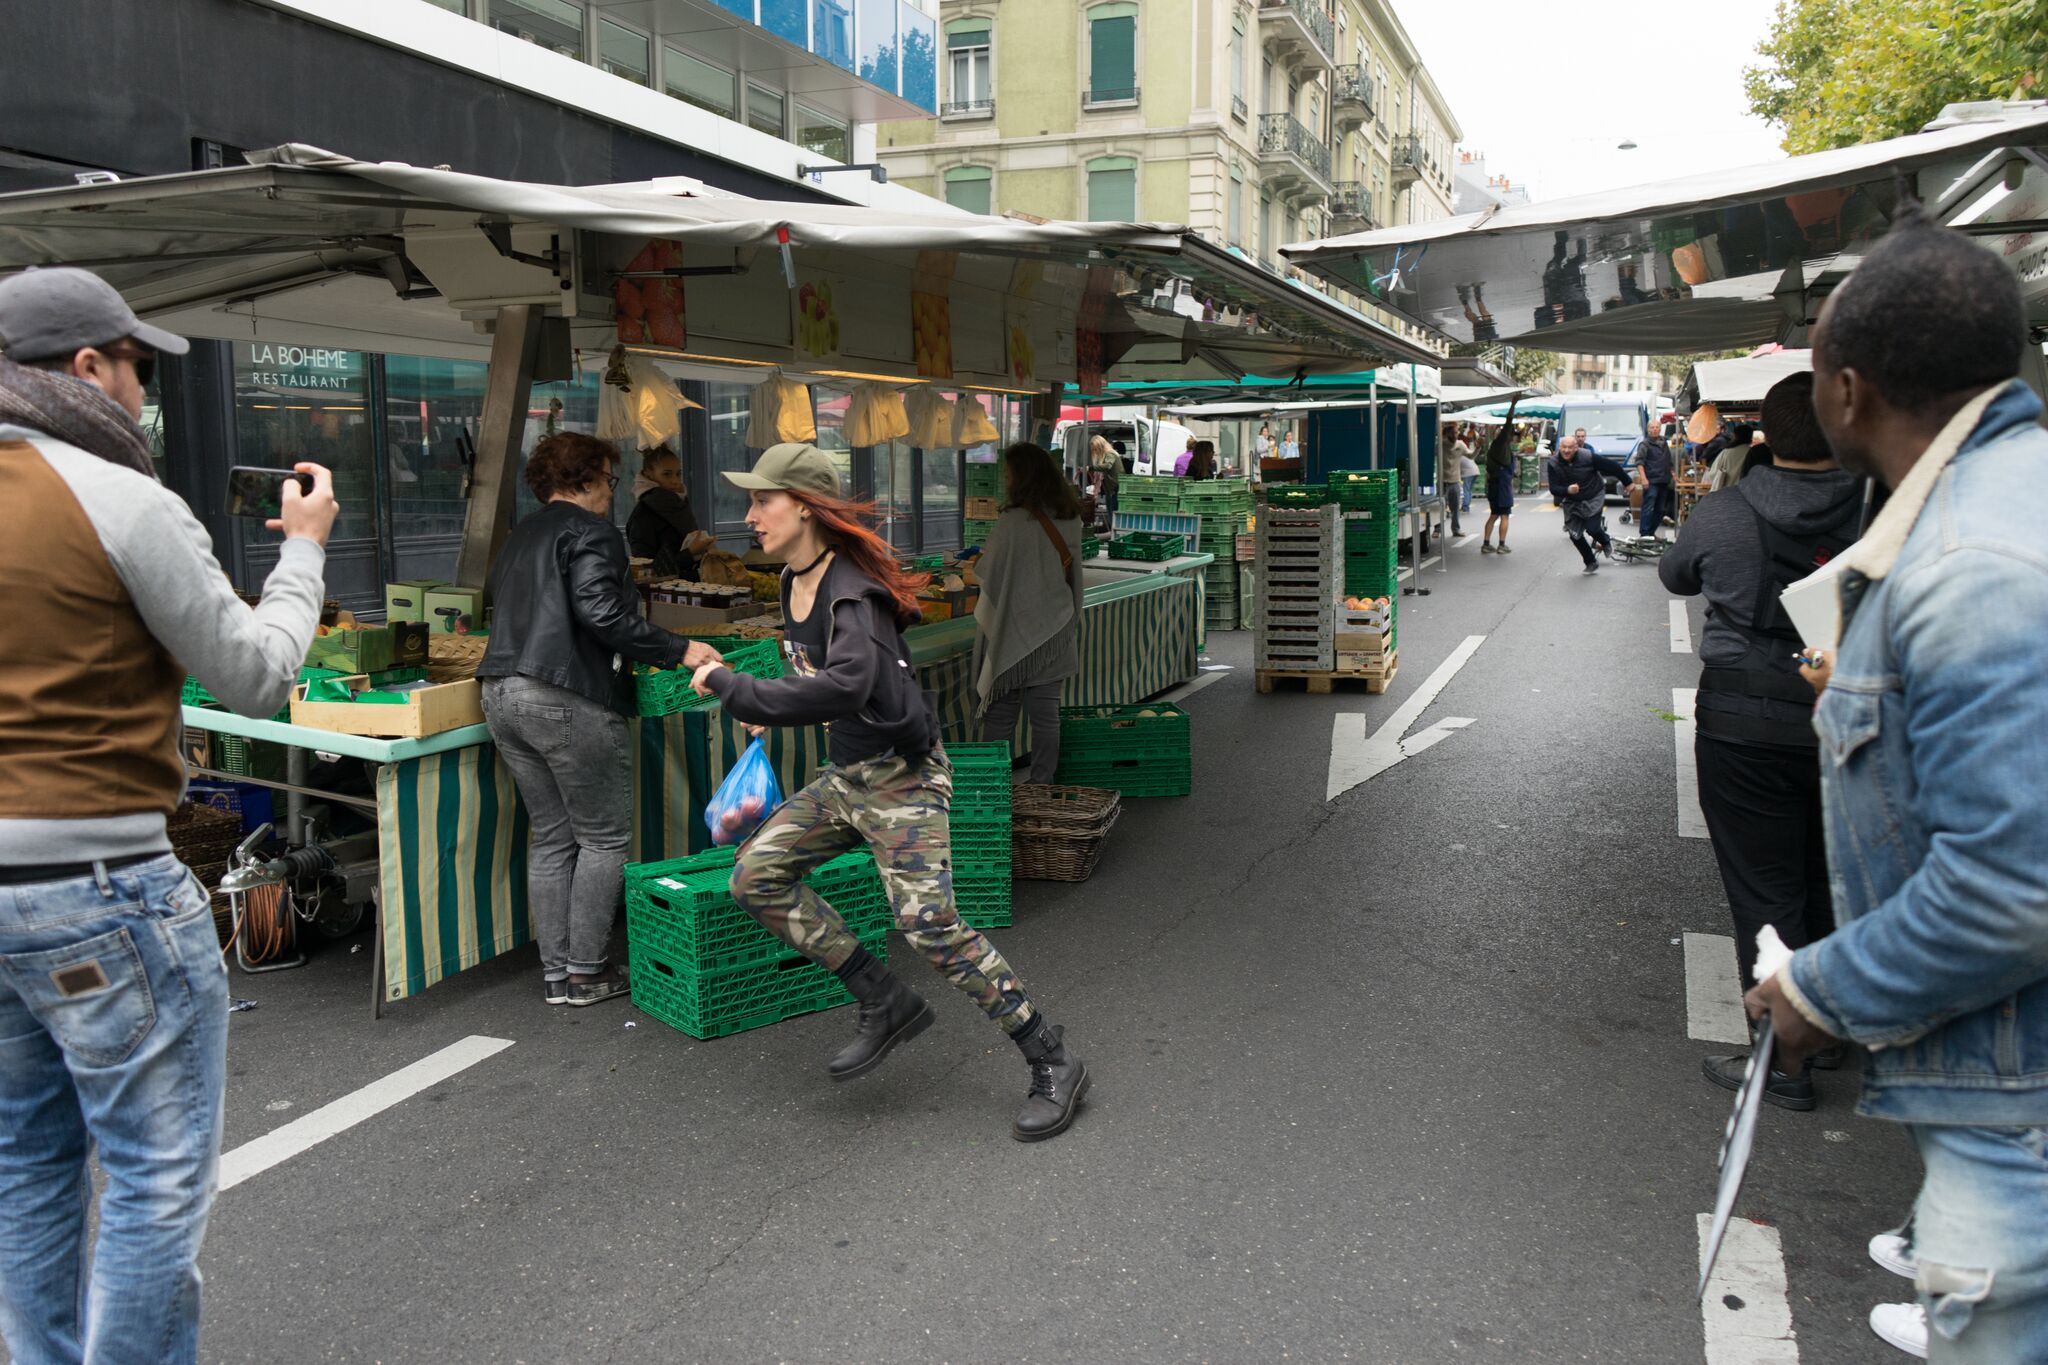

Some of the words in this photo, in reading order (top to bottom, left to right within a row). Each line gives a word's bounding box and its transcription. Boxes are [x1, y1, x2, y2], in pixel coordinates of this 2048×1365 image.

[251, 343, 275, 365] LA
[278, 345, 348, 369] BOHEME
[252, 372, 349, 389] RESTAURANT
